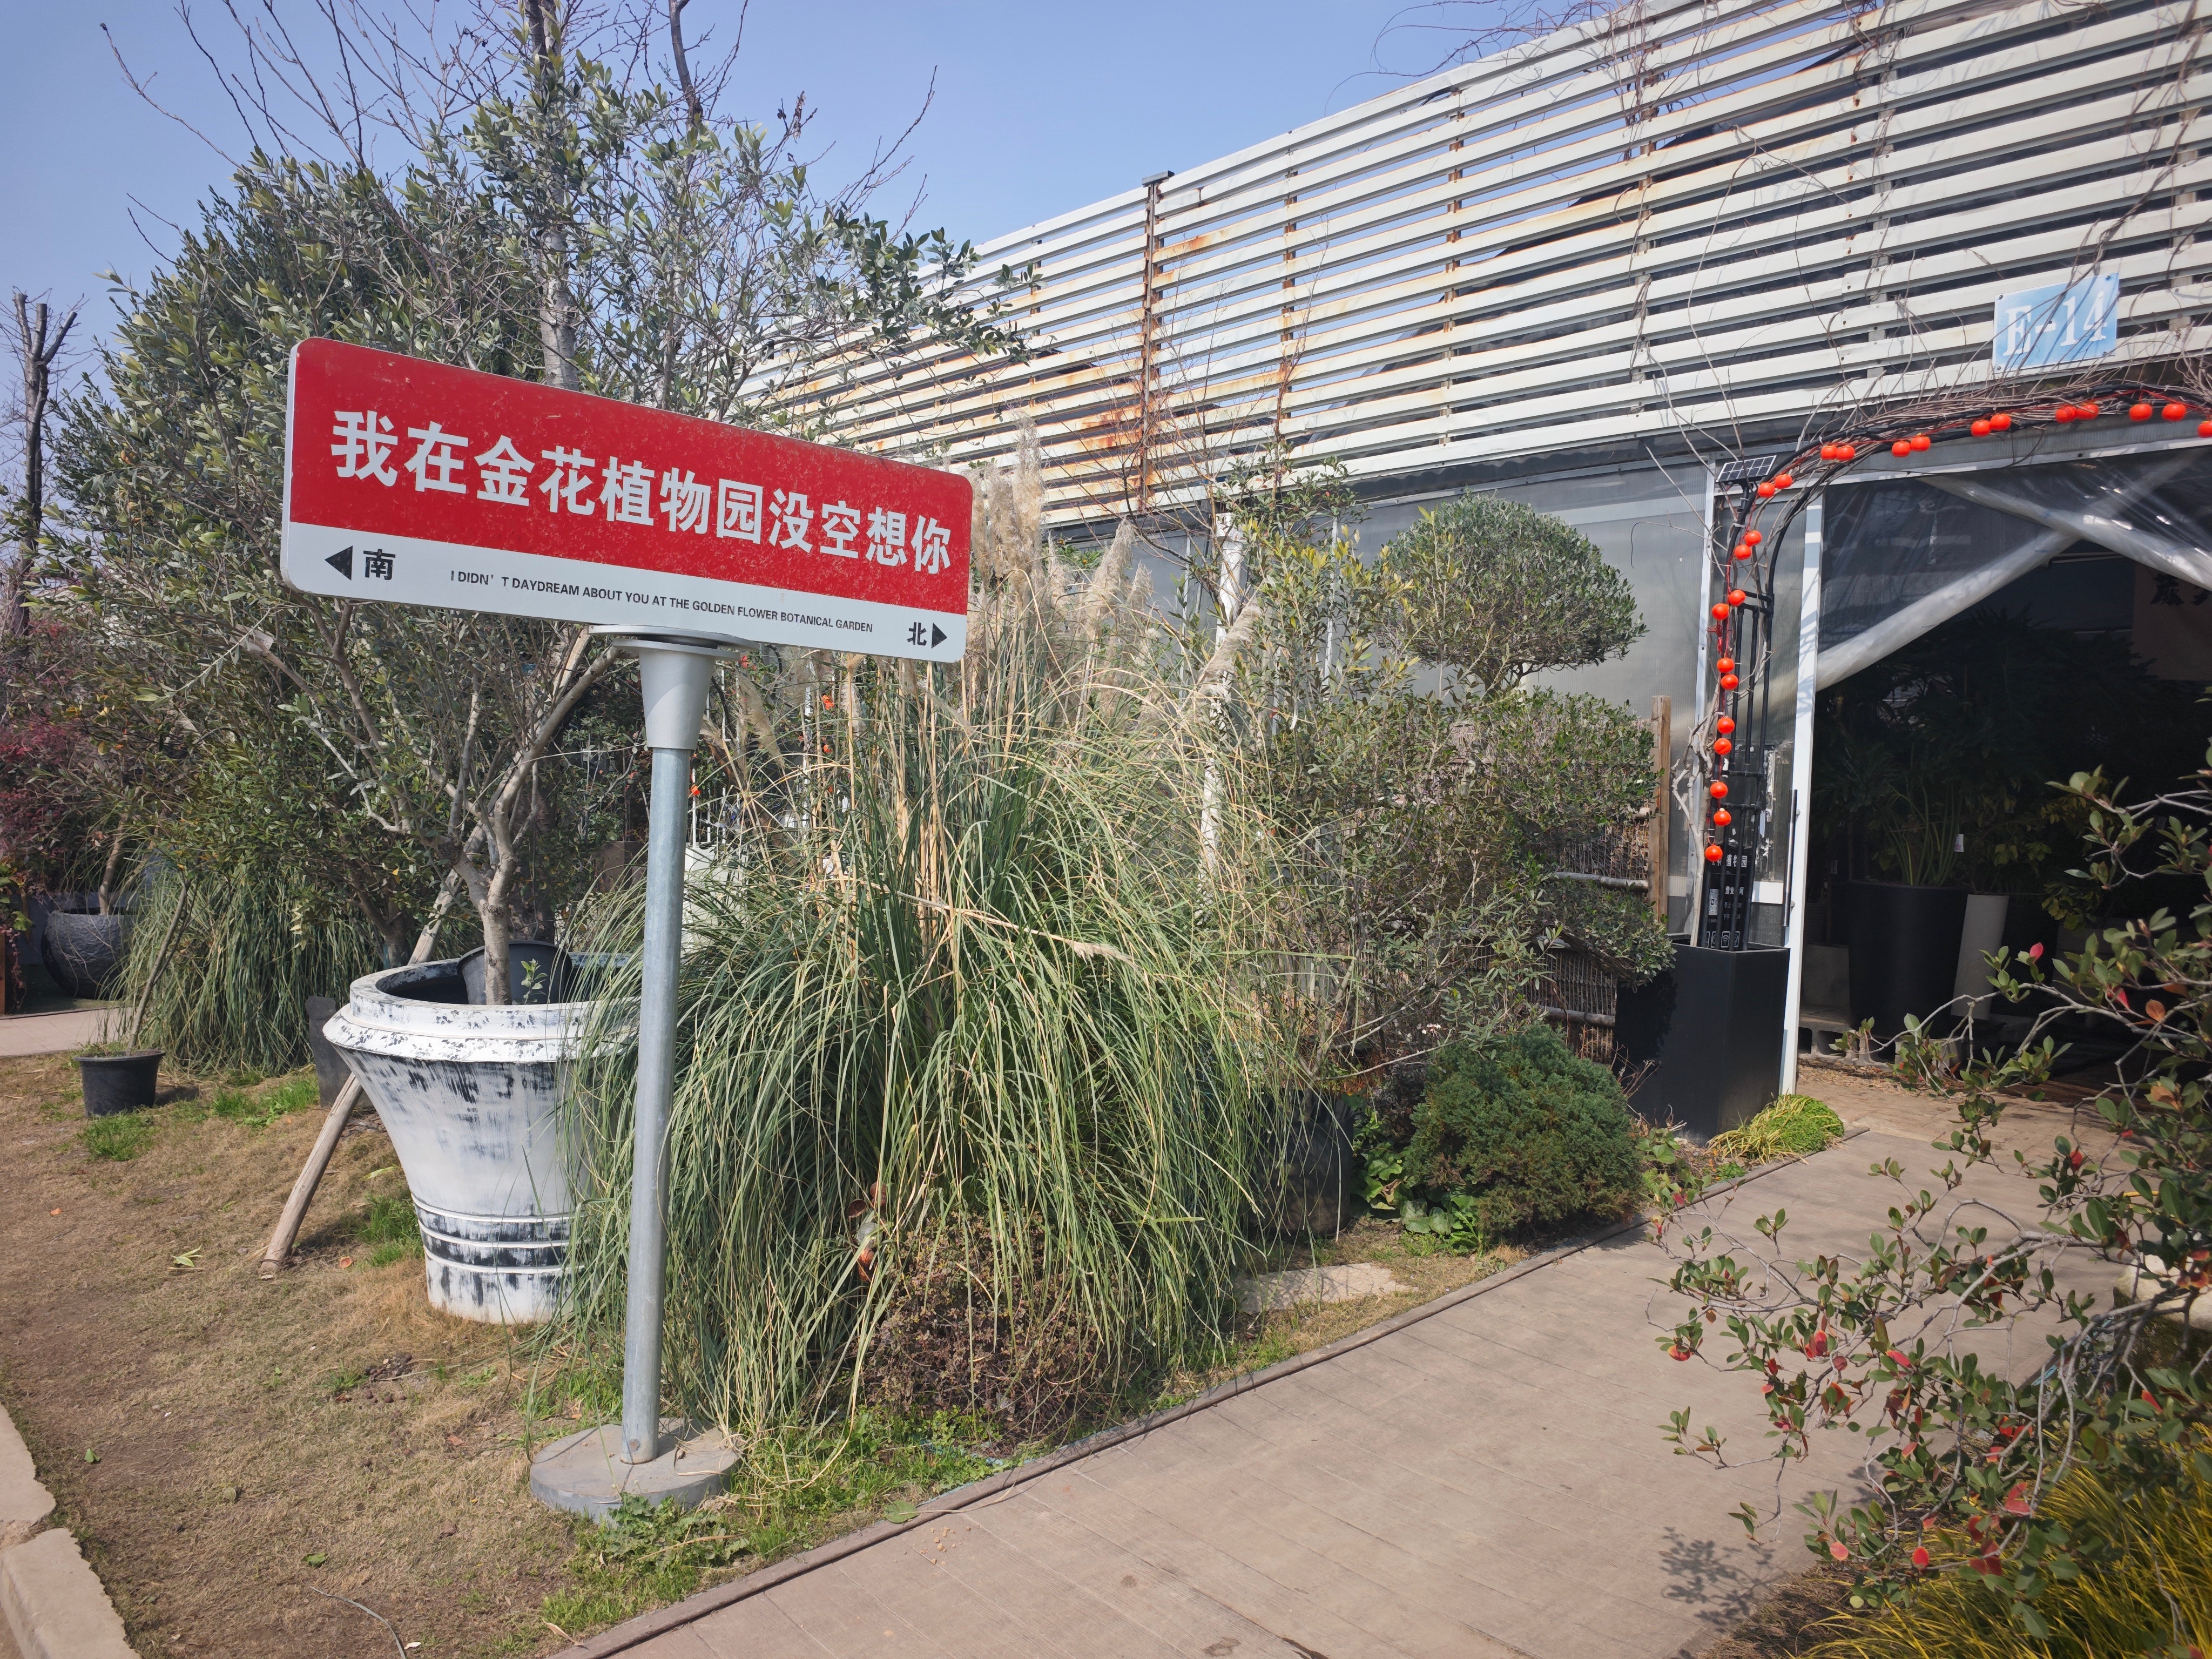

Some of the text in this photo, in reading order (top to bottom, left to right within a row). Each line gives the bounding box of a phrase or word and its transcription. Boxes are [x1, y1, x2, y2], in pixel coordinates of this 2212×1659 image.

[2003, 291, 2107, 356] E-14
[331, 410, 952, 575] 我在金花植物园没空想你
[363, 548, 396, 581] 南
[451, 570, 454, 581] I
[512, 577, 579, 596] DAYDREAM
[582, 586, 623, 601] ABOUT
[625, 592, 649, 604] YOU
[652, 596, 667, 606] AT
[669, 597, 690, 609] THE
[692, 601, 735, 615] GOLDEN
[738, 606, 778, 621] FLOWER
[780, 612, 833, 628] BOTANICAL
[835, 619, 873, 633] GARDEN
[907, 622, 927, 647] 北
